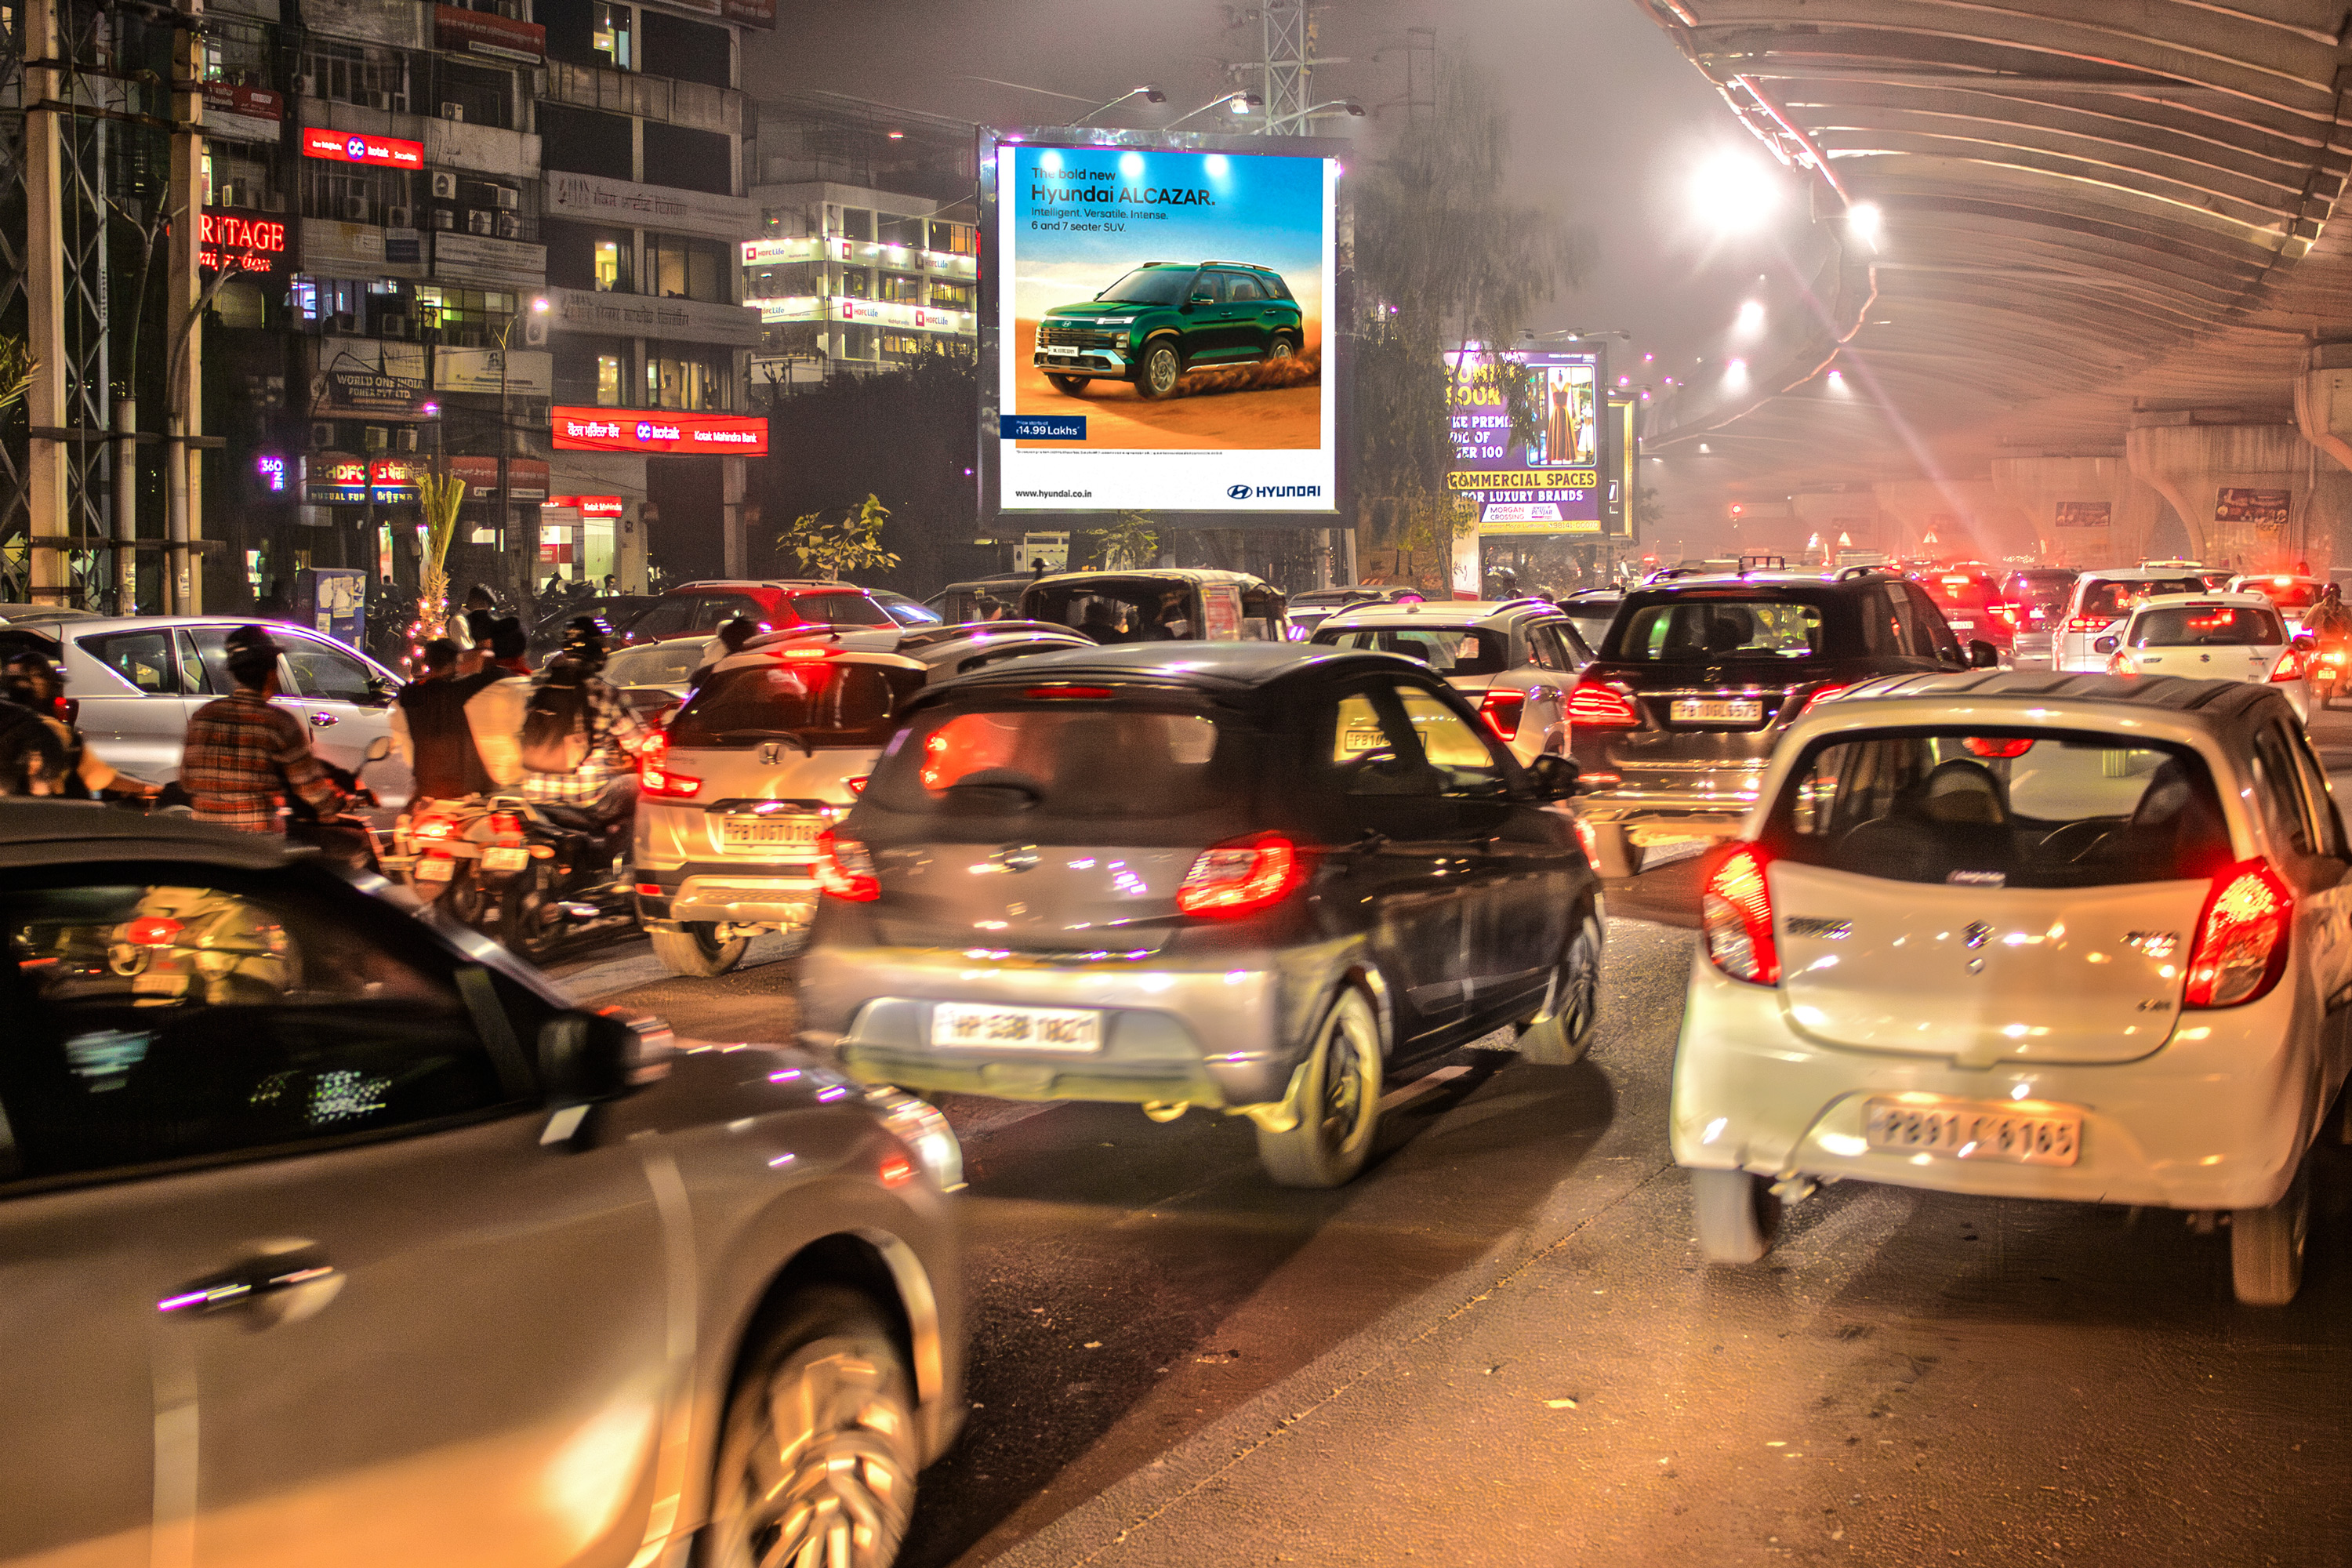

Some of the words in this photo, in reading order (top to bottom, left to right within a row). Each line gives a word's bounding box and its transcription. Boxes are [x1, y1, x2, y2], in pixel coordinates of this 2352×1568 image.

[1032, 167, 1054, 179] The
[1058, 169, 1086, 180] bold
[1090, 172, 1116, 180] new
[1032, 184, 1113, 204] Hyundai
[1118, 187, 1215, 205] ALCAZAR.
[1032, 207, 1082, 219] Intelligent.
[1083, 209, 1128, 218] Versatile.
[1131, 210, 1168, 220] Intense.
[1032, 221, 1038, 230] 6
[1040, 222, 1060, 230] and
[1062, 222, 1069, 230] 7
[1070, 223, 1101, 231] seater
[1104, 223, 1126, 232] SUV.
[336, 374, 372, 386] WORLD
[652, 426, 680, 439] kotak
[695, 430, 713, 441] Kotak
[713, 432, 741, 442] Mahindra
[742, 433, 757, 443] Bank
[1475, 431, 1490, 443] OF
[1481, 446, 1503, 459] 100
[261, 459, 283, 472] 360
[1449, 473, 1541, 488] COMMERCIAL
[1547, 473, 1595, 486] SPACES
[1015, 489, 1092, 499] www.hyundai.co.in
[1257, 485, 1320, 498] HYUNDAI
[1490, 491, 1534, 503] LUXURY
[1537, 490, 1584, 502] BRANDS
